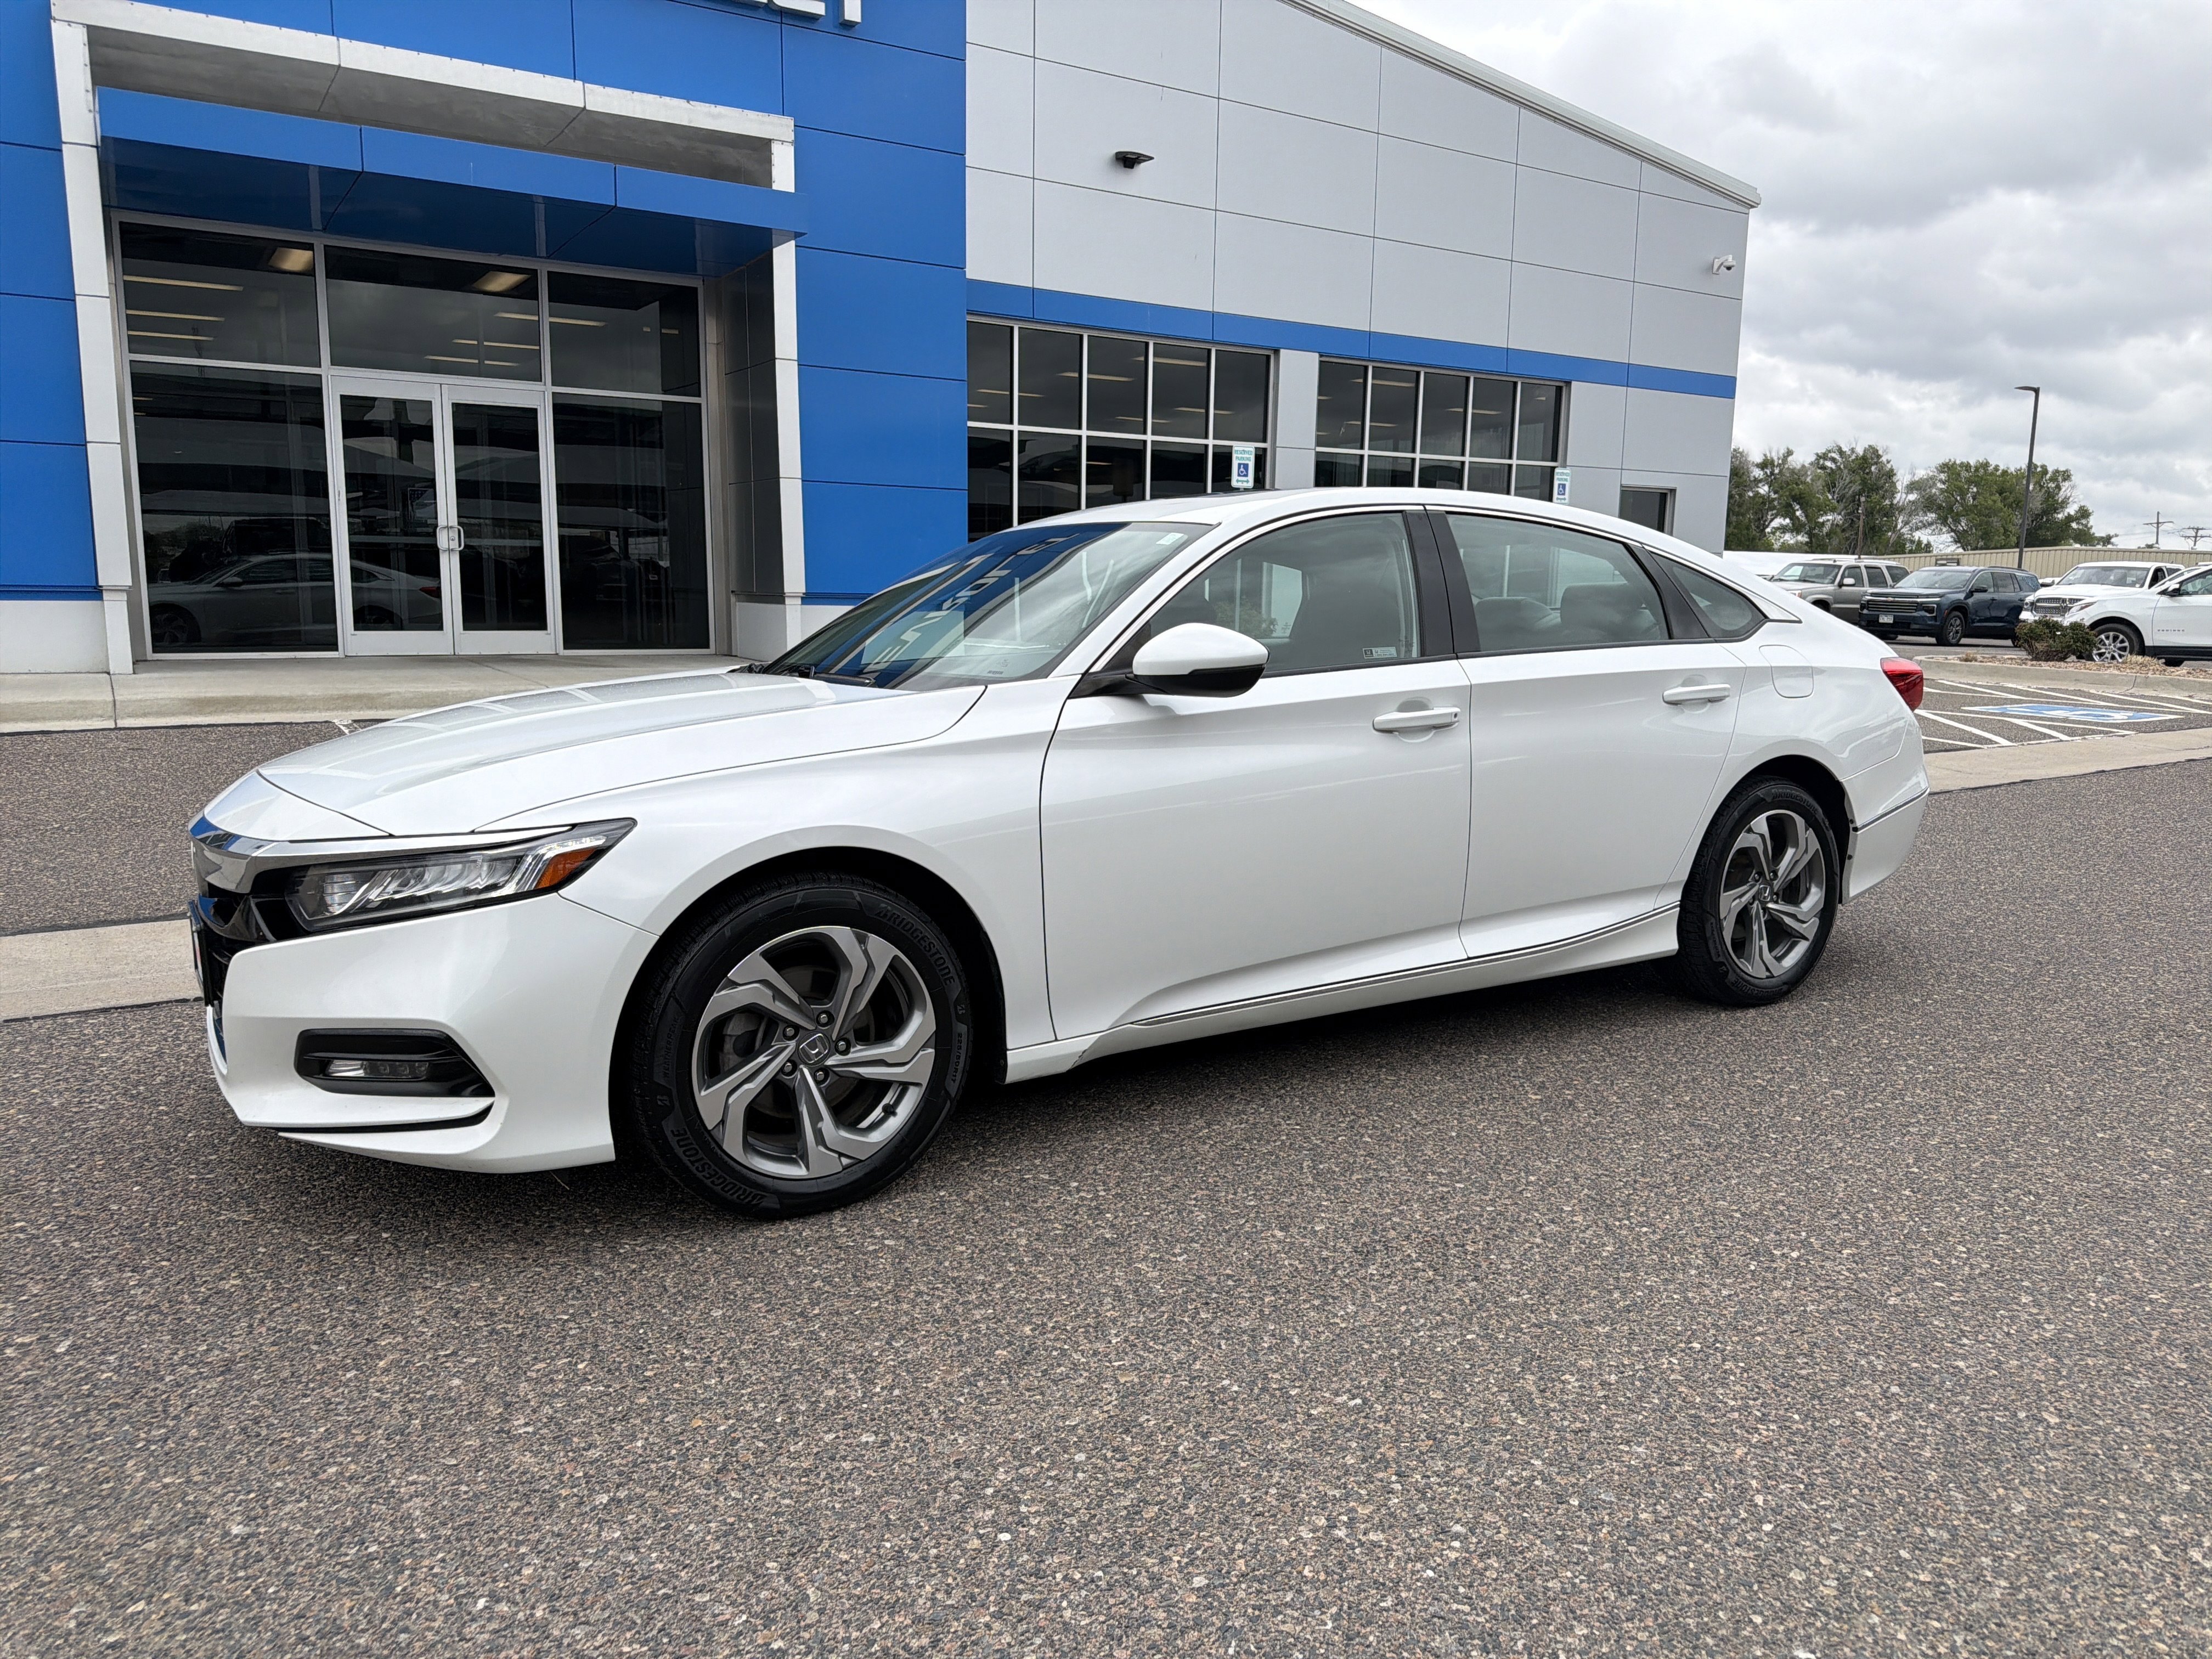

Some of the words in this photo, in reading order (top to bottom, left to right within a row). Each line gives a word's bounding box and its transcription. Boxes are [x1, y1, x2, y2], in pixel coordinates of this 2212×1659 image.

[874, 908, 956, 986] BRIDGESTONE
[662, 1017, 680, 1079] WEATHERPEAK
[670, 1127, 768, 1205] BRIDGESTONE
